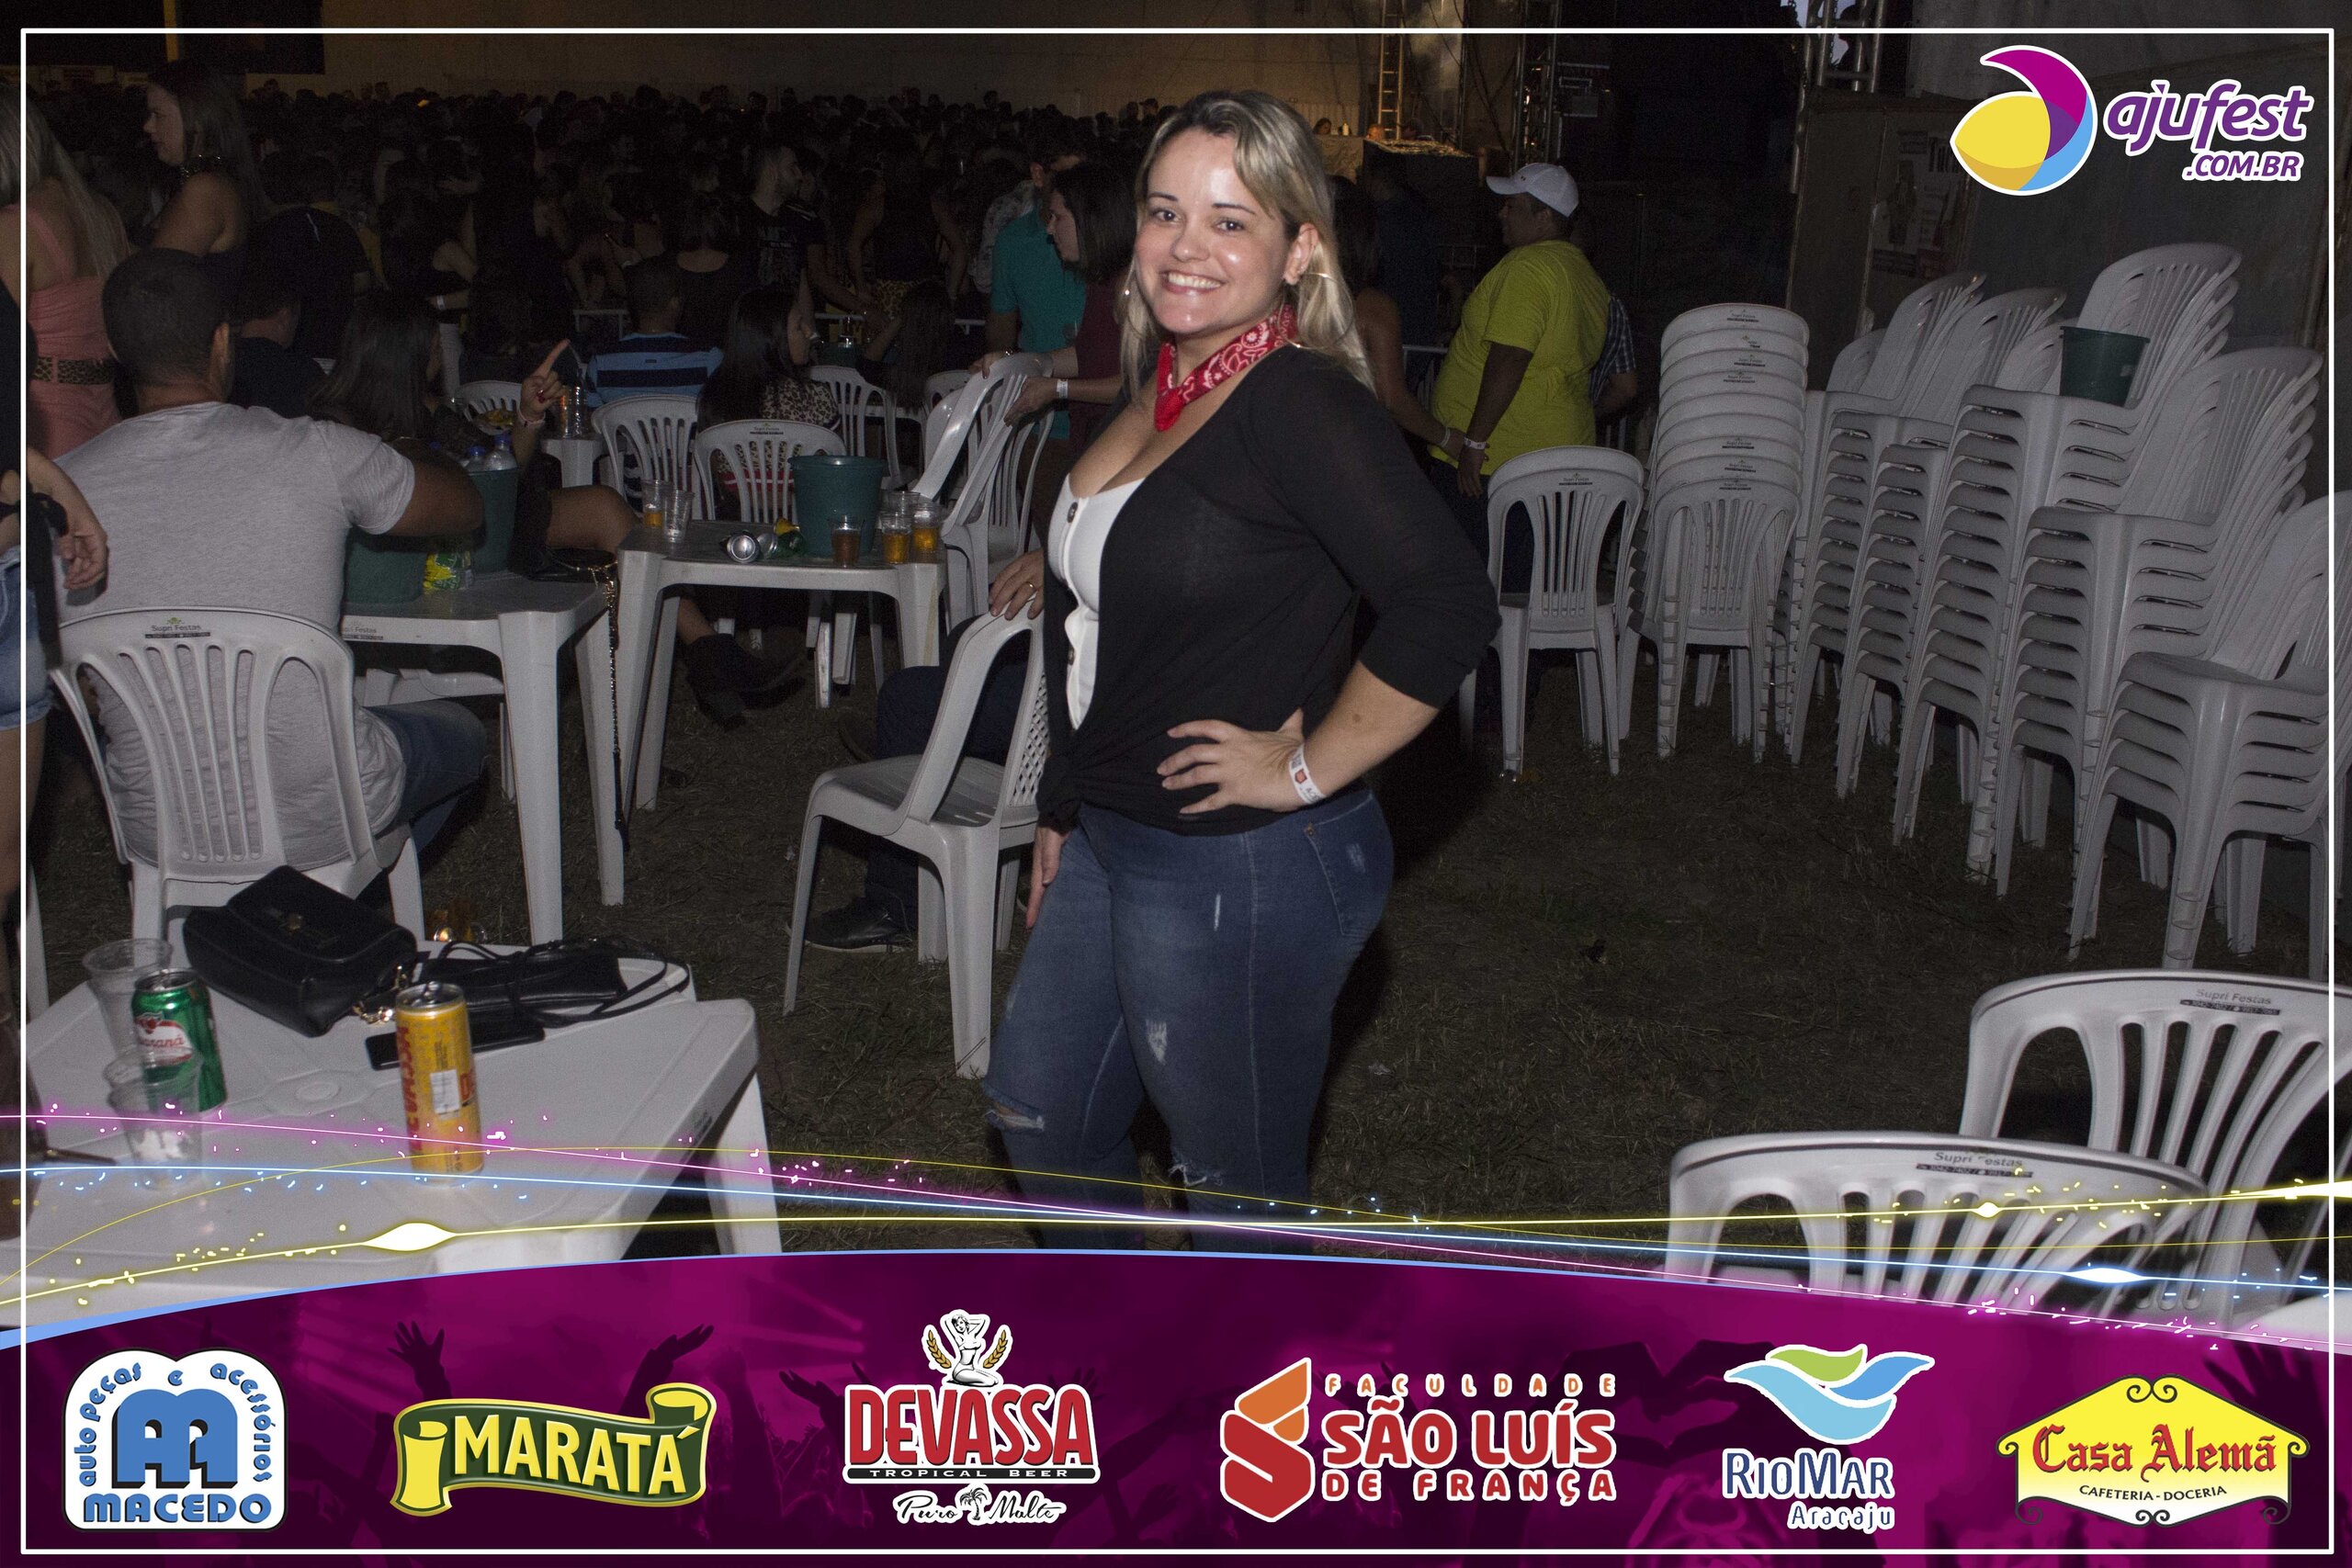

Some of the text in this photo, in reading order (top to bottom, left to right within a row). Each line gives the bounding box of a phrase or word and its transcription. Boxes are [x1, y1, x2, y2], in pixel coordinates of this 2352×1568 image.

[2195, 988, 2272, 1005] Supri Festas
[1933, 1151, 1973, 1165] Supri
